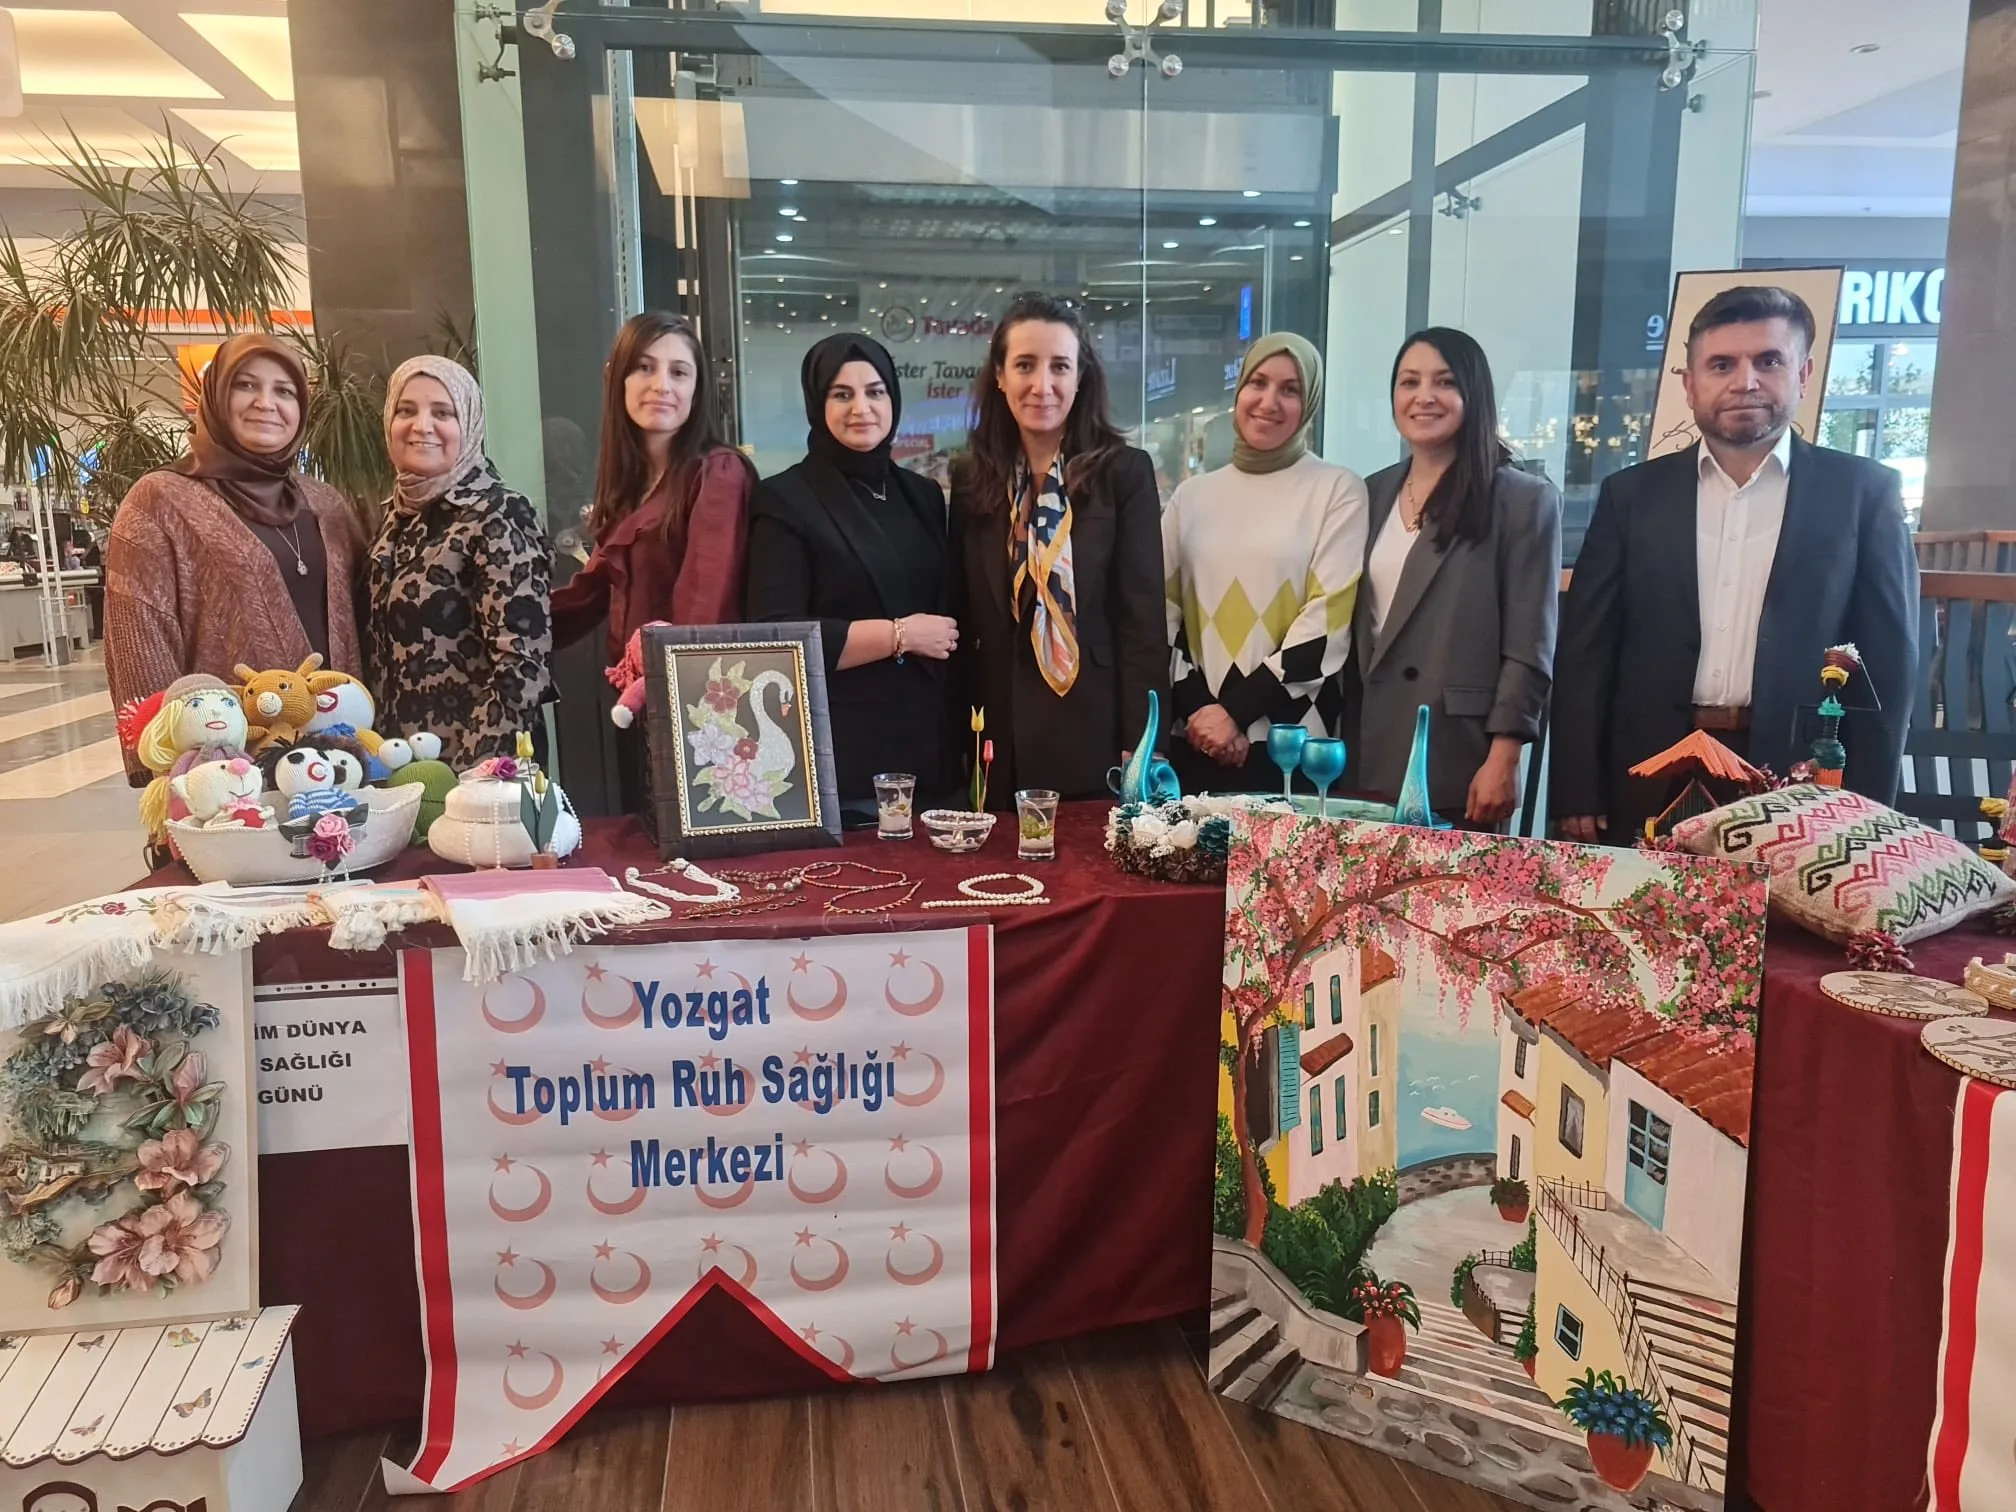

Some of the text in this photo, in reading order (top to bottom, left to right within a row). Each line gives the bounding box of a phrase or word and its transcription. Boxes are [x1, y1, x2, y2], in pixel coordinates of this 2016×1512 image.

[932, 361, 980, 379] Tava
[632, 976, 771, 1041] Yozgat
[286, 1019, 367, 1038] DÜNYA
[259, 1050, 352, 1072] SAĞLIĞI
[257, 1084, 324, 1104] GÜNÜ
[506, 1050, 895, 1125] Toplum Ruh Sağlığı
[630, 1133, 784, 1188] Merkezi
